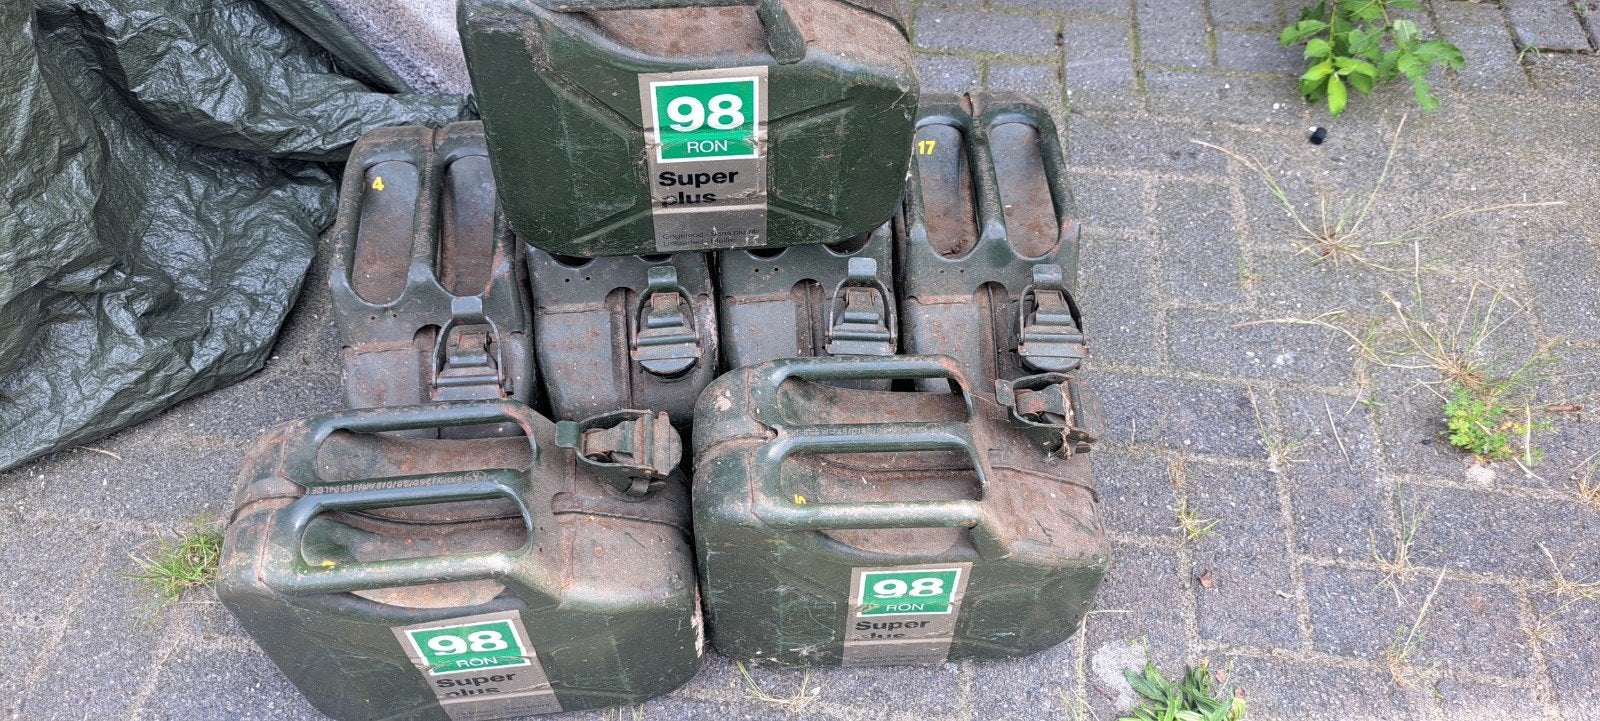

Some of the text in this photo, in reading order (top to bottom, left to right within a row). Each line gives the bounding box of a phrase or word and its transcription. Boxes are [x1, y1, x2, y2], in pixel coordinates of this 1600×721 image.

[667, 93, 744, 132] 98
[687, 140, 728, 153] RON
[918, 140, 936, 155] 17
[372, 176, 385, 191] 4
[659, 171, 738, 188] Super
[661, 191, 717, 208] plus
[873, 577, 944, 599] 98
[886, 603, 924, 612] RON
[855, 620, 931, 631] Super
[427, 630, 508, 656] 98
[456, 657, 498, 668] RON
[436, 673, 516, 688] Super
